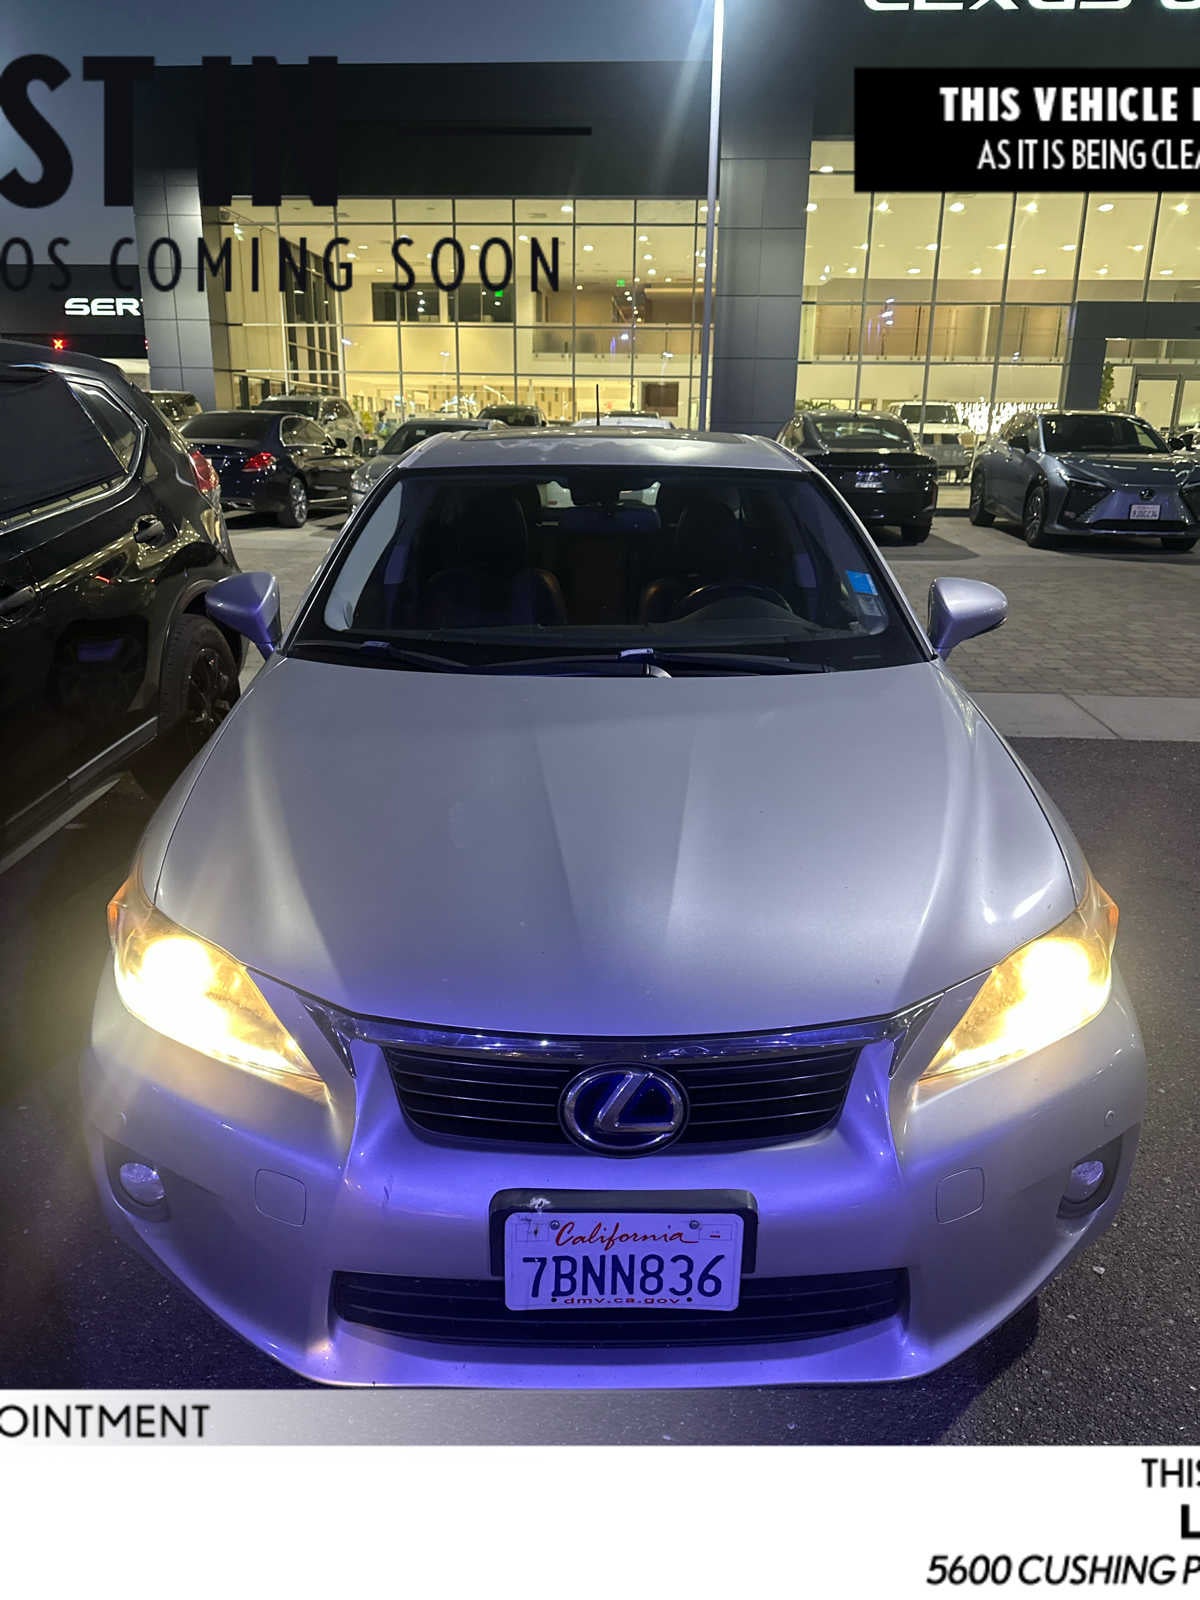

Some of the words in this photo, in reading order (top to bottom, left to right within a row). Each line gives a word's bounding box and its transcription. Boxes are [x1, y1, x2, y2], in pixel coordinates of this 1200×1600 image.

[64, 297, 144, 316] SER
[555, 1221, 699, 1251] California
[522, 1254, 725, 1298] 7BNN836
[563, 1297, 680, 1305] dmv.ca.gov
